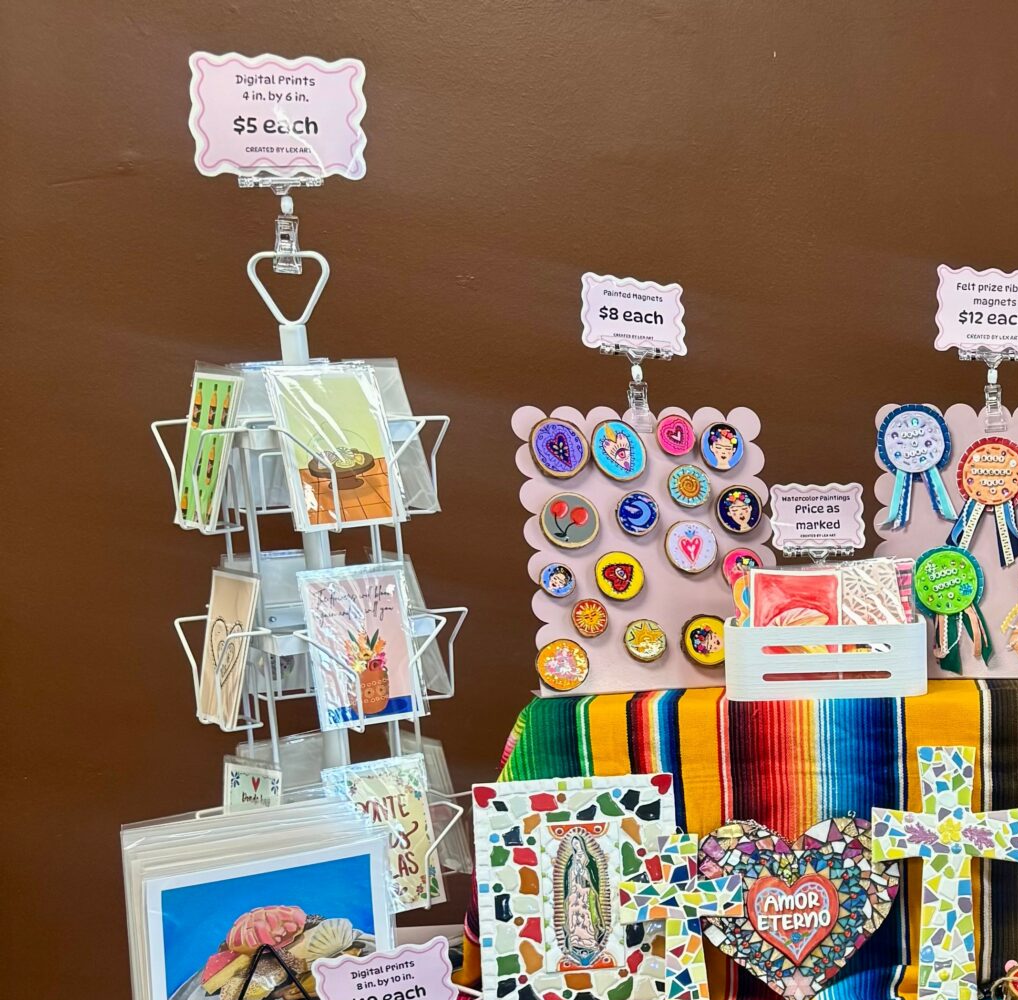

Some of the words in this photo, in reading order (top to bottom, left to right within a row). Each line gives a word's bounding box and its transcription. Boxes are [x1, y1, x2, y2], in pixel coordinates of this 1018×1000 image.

[236, 75, 275, 86] Digital
[279, 76, 315, 86] Prints
[269, 92, 283, 102] by
[286, 92, 292, 101] 6
[295, 92, 309, 102] in.
[234, 116, 257, 134] $5
[263, 117, 318, 134] each
[978, 284, 1002, 292] prize
[604, 290, 630, 299] Painted
[633, 294, 663, 302] Magnets
[973, 298, 1016, 307] magnets
[600, 306, 618, 320] $8
[623, 310, 663, 324] each
[959, 310, 983, 324] $12
[795, 504, 823, 514] Price
[796, 520, 840, 530] marked
[764, 891, 820, 912] AMOR
[758, 910, 830, 930] ETERNO
[351, 966, 384, 979] Digital
[386, 961, 415, 972] Prints
[378, 978, 389, 987] by
